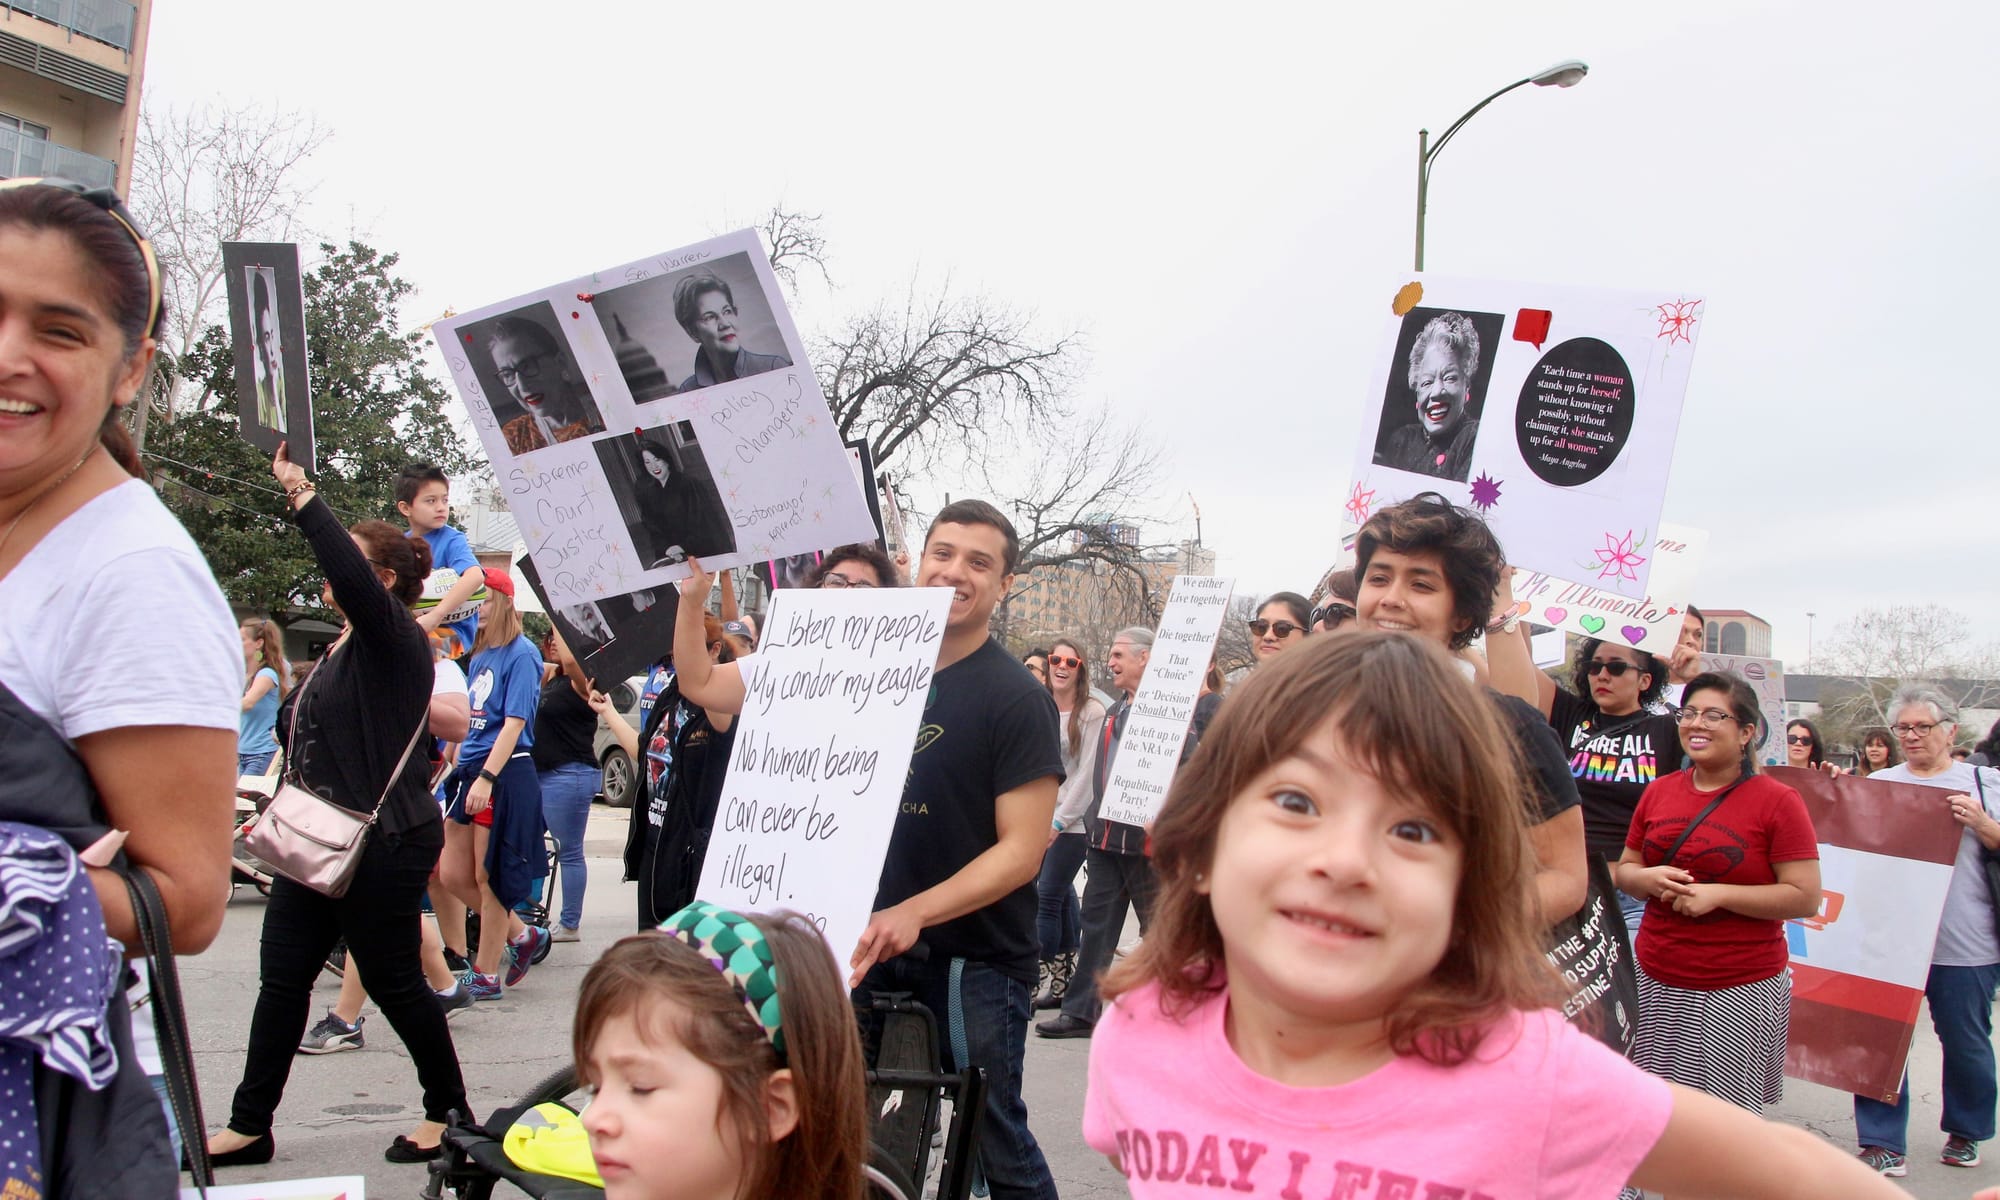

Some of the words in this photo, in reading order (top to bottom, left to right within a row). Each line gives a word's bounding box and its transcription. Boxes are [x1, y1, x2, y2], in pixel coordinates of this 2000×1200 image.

[625, 267, 650, 282] Sen
[659, 251, 711, 271] Warren
[1542, 364, 1565, 376] "Each
[1566, 368, 1585, 381] time
[1586, 373, 1591, 381] a
[1594, 374, 1624, 385] woman
[1537, 379, 1563, 391] stands
[1564, 383, 1575, 394] up
[1577, 383, 1589, 393] for
[1590, 386, 1621, 400] herself,
[711, 391, 774, 433] policy
[1538, 393, 1568, 406] without
[1570, 396, 1605, 414] knowing
[1606, 403, 1613, 413] it
[1538, 409, 1572, 424] possibly,
[1574, 413, 1606, 427] without
[1525, 419, 1560, 435] claiming
[1561, 424, 1569, 436] it,
[1571, 427, 1585, 438] she
[1586, 430, 1615, 443] stands
[1530, 436, 1541, 447] up
[1542, 437, 1554, 446] for
[1554, 438, 1566, 449] all
[1567, 443, 1604, 455] women."
[1560, 458, 1587, 470] Angelou
[537, 485, 595, 527] Court
[535, 524, 606, 569] Justice
[551, 544, 611, 599] "Power"
[1183, 577, 1197, 588] We
[1198, 577, 1224, 589] either
[1515, 572, 1550, 600] Me
[1169, 593, 1189, 604] Live
[1191, 594, 1226, 607] together
[762, 598, 834, 654] Listen
[842, 615, 874, 650] my
[868, 610, 939, 658] people
[1186, 616, 1197, 625] or
[1158, 628, 1172, 640] Die
[1174, 631, 1215, 643] together!
[1169, 653, 1189, 666] That
[1153, 667, 1193, 680] "Choice"
[746, 660, 776, 716] My
[781, 658, 843, 700] condor
[843, 671, 875, 714] my
[876, 658, 930, 706] eagle
[1139, 689, 1149, 698] or
[1151, 689, 1195, 705] 'Decision'
[1134, 702, 1167, 717] 'Should
[1169, 707, 1191, 720] Not'
[1128, 725, 1138, 736] be
[1140, 727, 1155, 739] left
[1157, 729, 1169, 743] up
[1171, 731, 1180, 741] to
[1584, 734, 1621, 756] ARE
[1622, 733, 1655, 756] ALL
[1124, 740, 1138, 751] the
[1142, 741, 1161, 755] NRA
[1164, 747, 1175, 757] or
[735, 729, 757, 773] No
[762, 731, 821, 783] human
[824, 734, 880, 796] being
[1137, 757, 1152, 769] the
[1567, 751, 1656, 784] OMAN
[1113, 775, 1163, 795] Republican
[1120, 791, 1149, 809] Party!
[725, 797, 759, 833] can
[761, 803, 807, 834] ever
[805, 793, 839, 841] be
[1105, 805, 1122, 818] You
[720, 844, 793, 905] illegal.
[1554, 935, 1586, 960] THE
[1563, 973, 1611, 1018] ESTINE
[1115, 1128, 1268, 1192] TODAY
[1281, 1150, 1310, 1200] I
